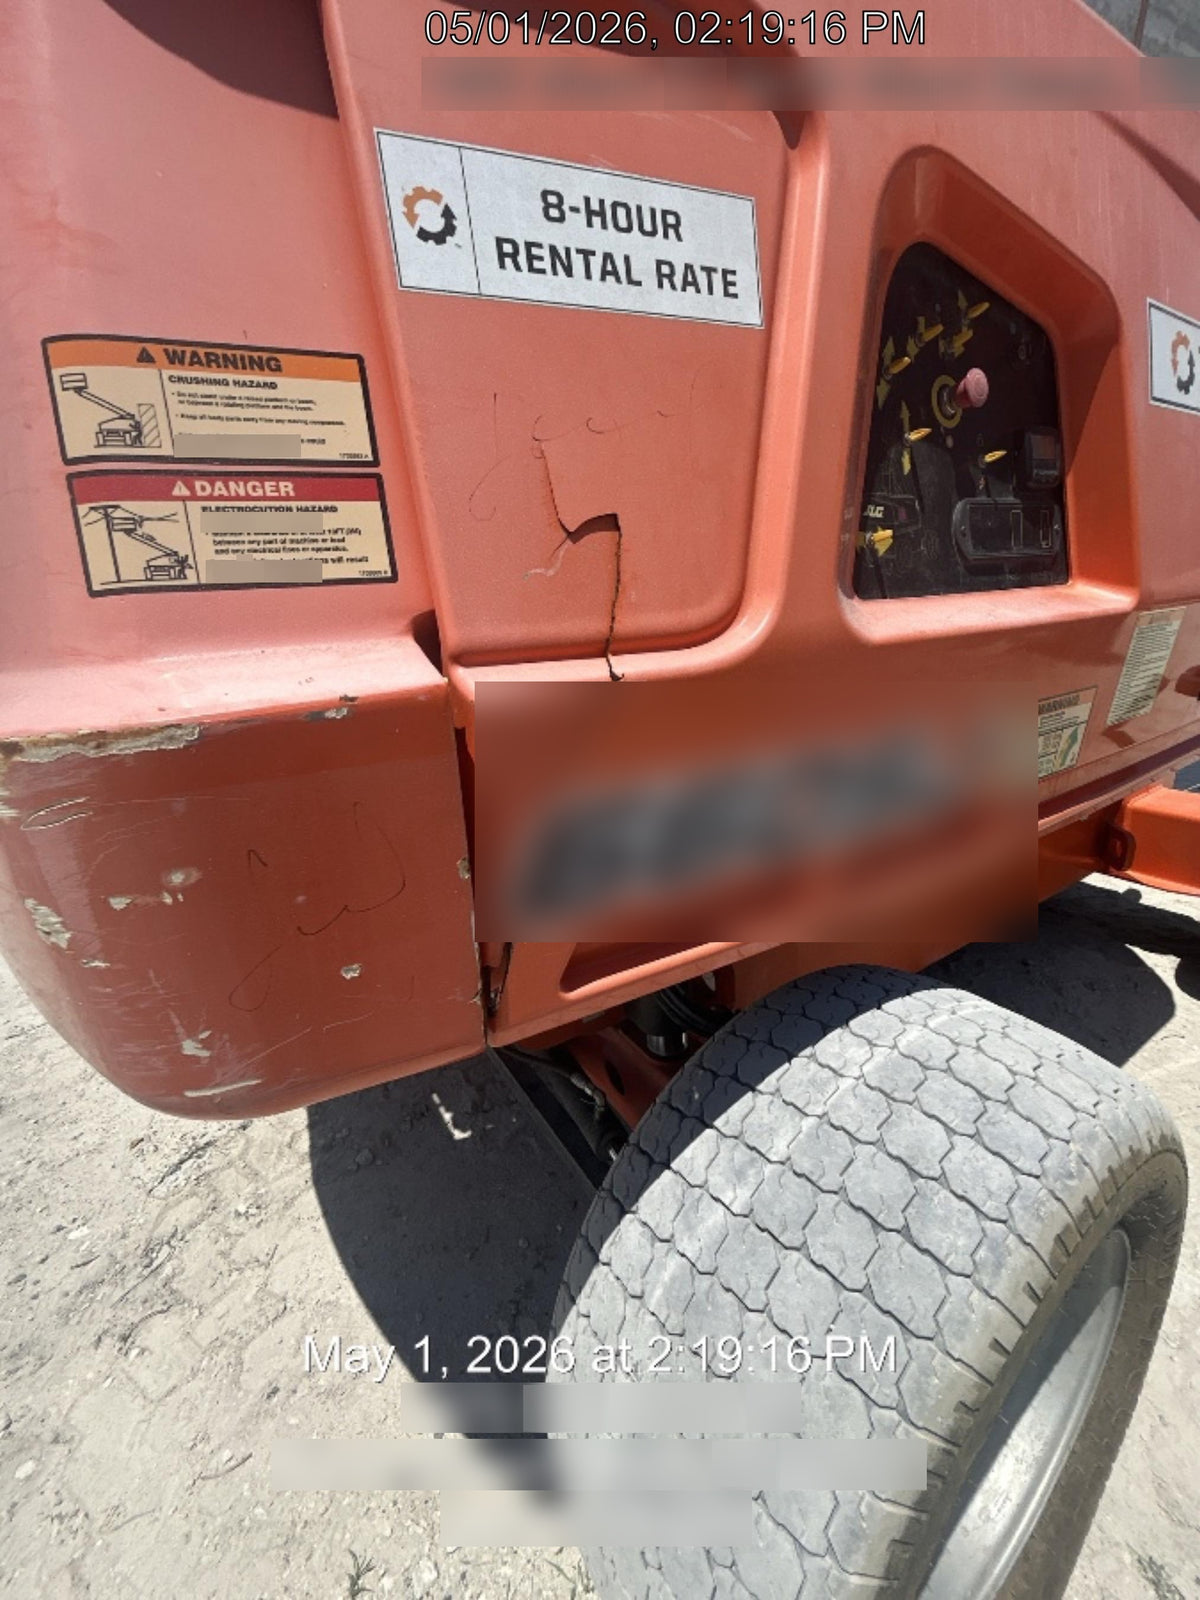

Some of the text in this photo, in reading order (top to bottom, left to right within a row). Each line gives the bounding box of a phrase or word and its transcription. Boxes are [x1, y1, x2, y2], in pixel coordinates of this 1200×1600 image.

[540, 189, 684, 242] 8-HOUR
[495, 236, 739, 299] RENTAL RATE
[164, 347, 282, 372] WARNING
[168, 374, 278, 390] CRUSHING HAZARD
[194, 480, 295, 497] DANGER
[201, 504, 339, 513] ELECTROCUTION HAZARD
